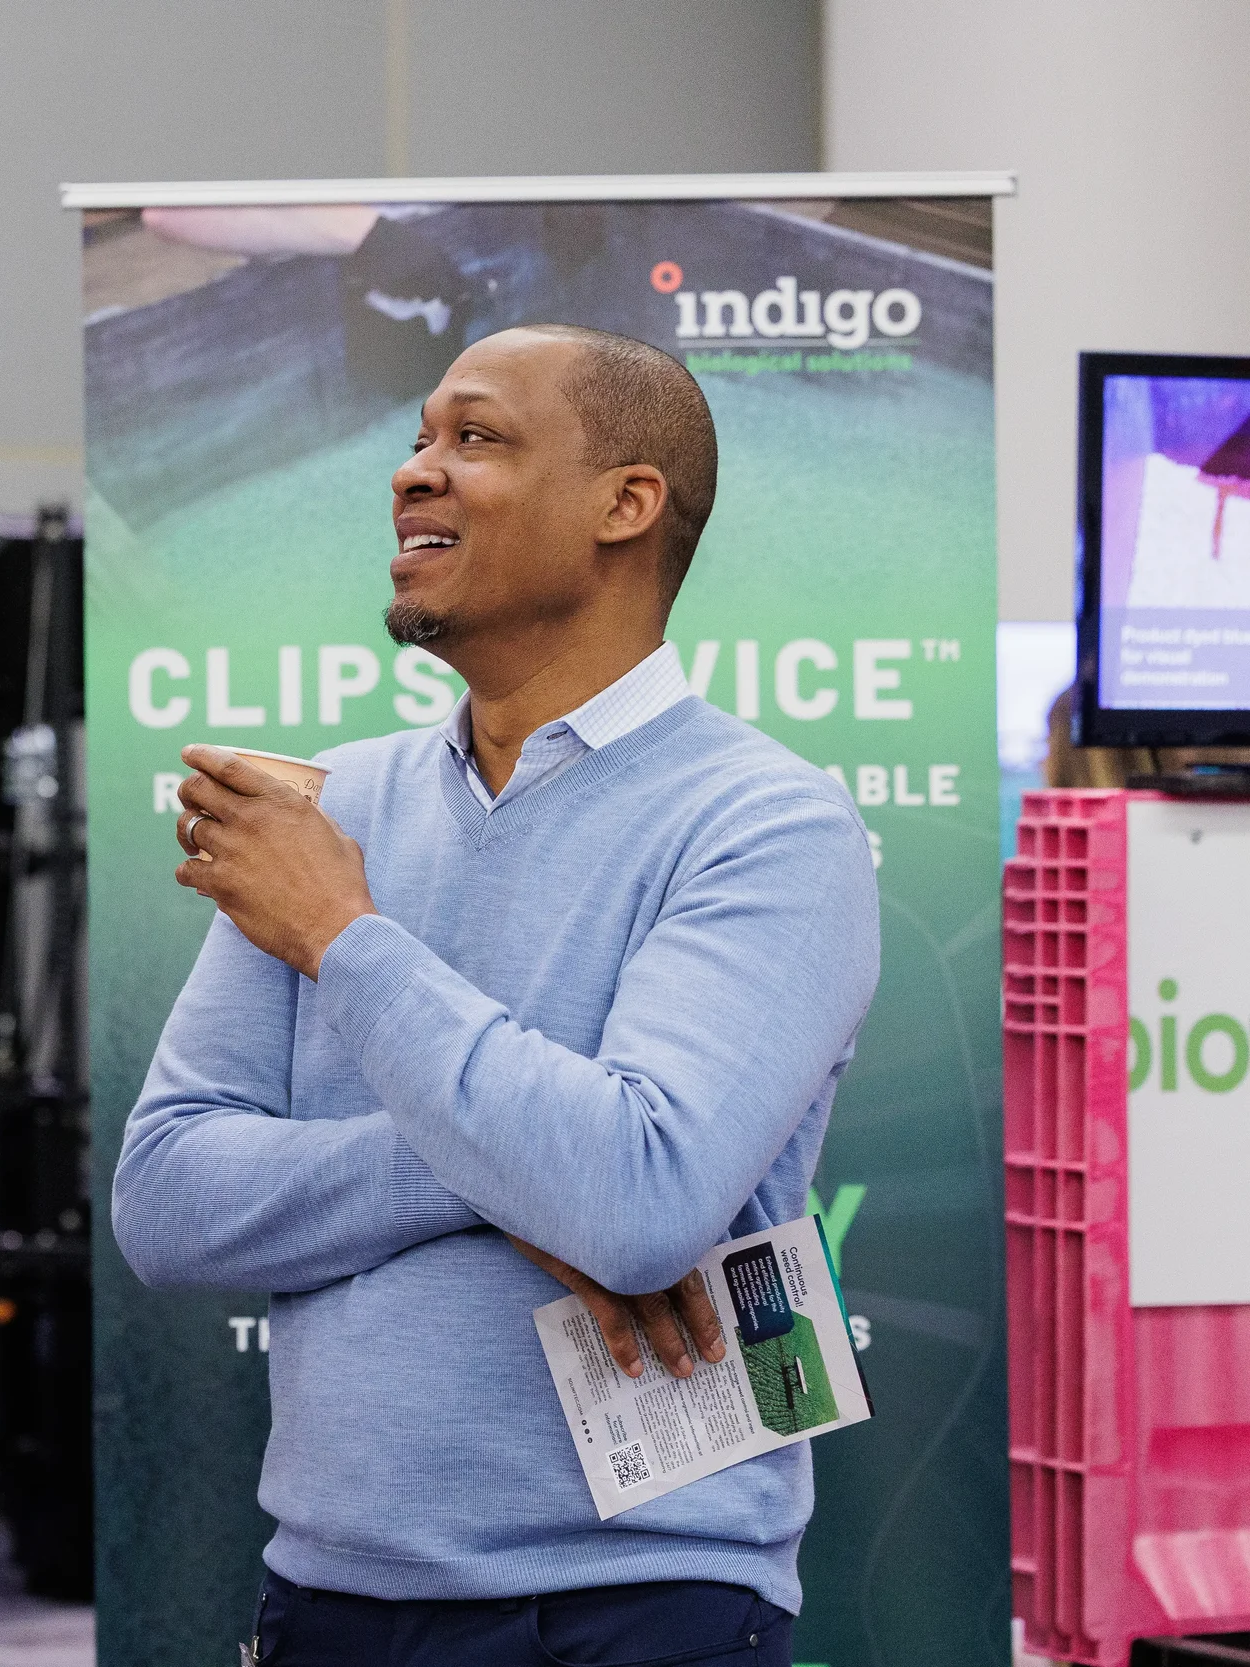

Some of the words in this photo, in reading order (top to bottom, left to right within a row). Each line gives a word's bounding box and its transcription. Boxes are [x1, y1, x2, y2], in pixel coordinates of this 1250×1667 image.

[650, 261, 922, 350] indigo
[129, 645, 457, 728] CLIPS
[744, 1262, 753, 1281] market
[749, 1281, 760, 1306] including
[750, 1259, 759, 1275] entire
[755, 1275, 769, 1306] agricultural
[757, 1257, 765, 1269] and
[761, 1269, 771, 1294] efficiency
[764, 1255, 777, 1282] Enhanced
[771, 1282, 785, 1313] productivity
[780, 1248, 794, 1273] weed
[787, 1274, 803, 1307] control!
[789, 1246, 807, 1296] Continuous
[737, 1264, 746, 1287] farmers,
[743, 1286, 751, 1300] seed
[747, 1300, 759, 1331] companies,
[614, 1428, 622, 1443] more
[616, 1414, 627, 1441] Subscribe
